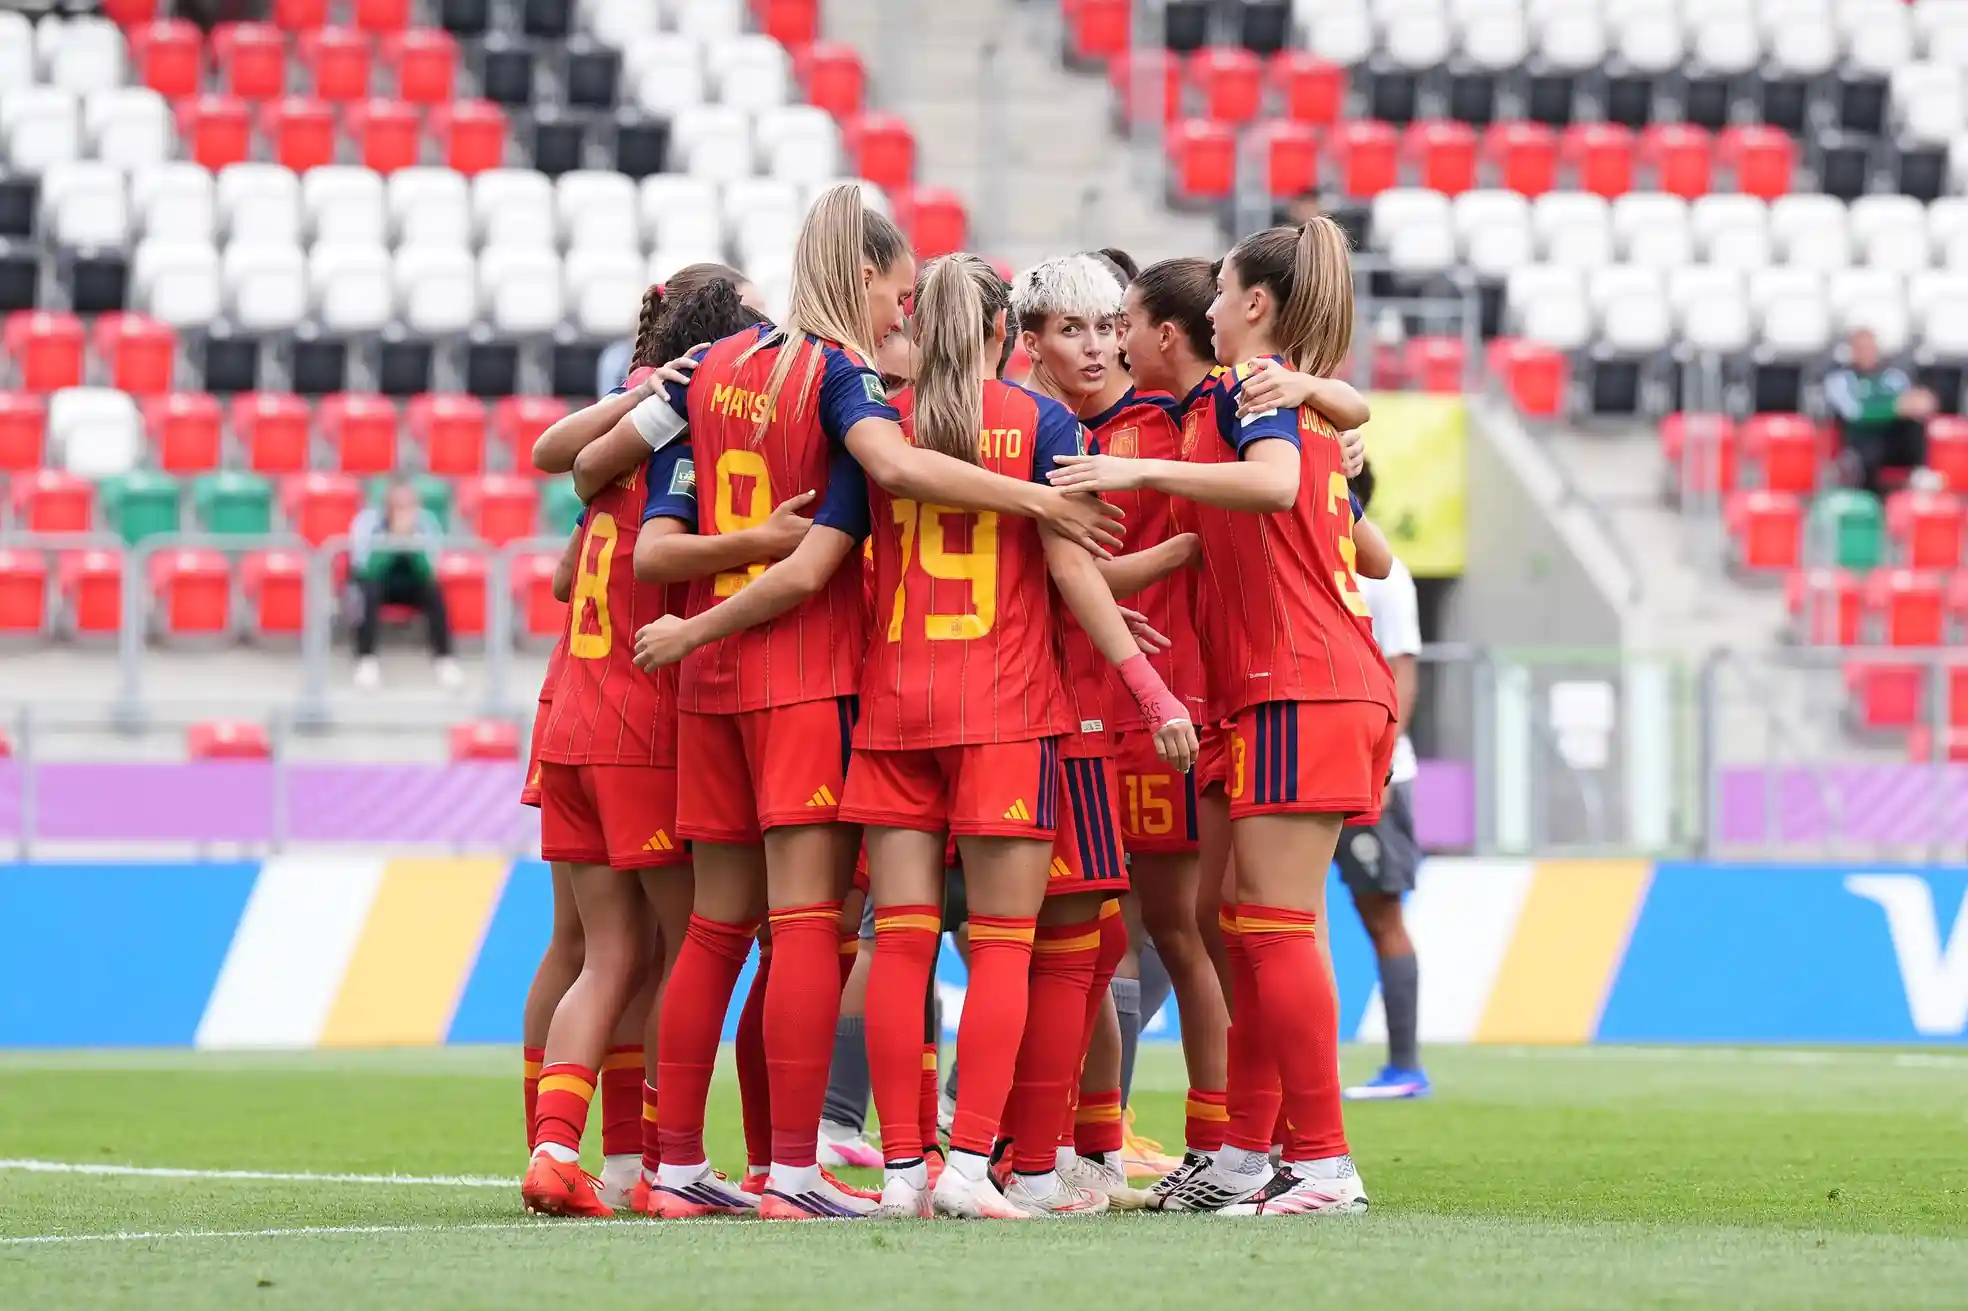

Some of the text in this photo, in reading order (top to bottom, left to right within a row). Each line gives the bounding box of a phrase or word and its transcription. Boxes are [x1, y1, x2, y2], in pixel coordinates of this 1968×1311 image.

[569, 511, 618, 659] 8
[713, 449, 772, 597] 9
[887, 498, 998, 642] 19
[1327, 471, 1372, 617] 3
[1125, 774, 1173, 835] 15
